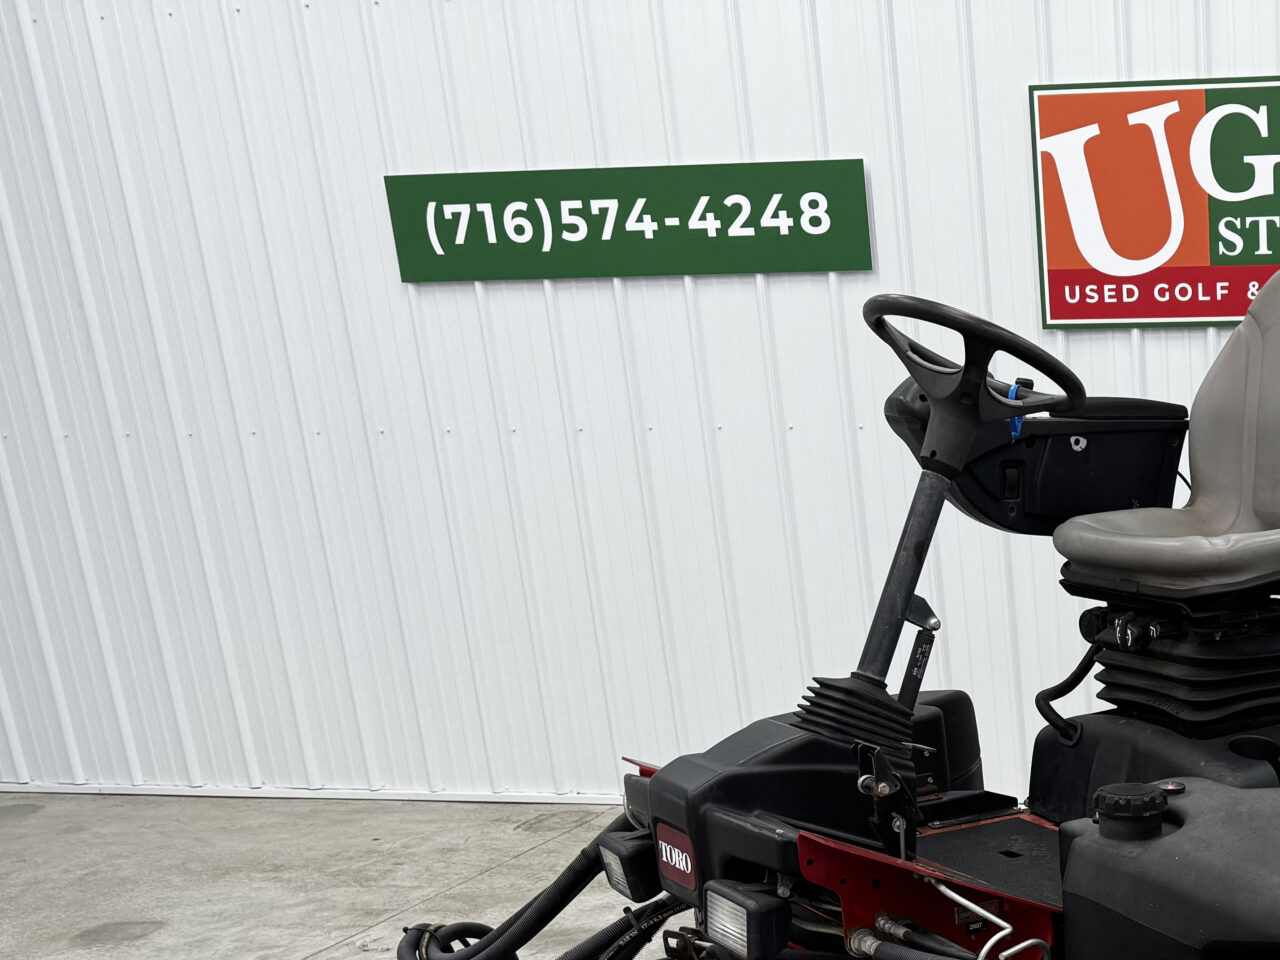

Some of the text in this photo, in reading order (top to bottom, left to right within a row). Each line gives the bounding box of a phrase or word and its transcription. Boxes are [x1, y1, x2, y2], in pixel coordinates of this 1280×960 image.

[425, 191, 832, 256] (716)574-4248
[1064, 284, 1140, 304] USED
[1153, 282, 1230, 302] GOLF
[1246, 281, 1261, 300] &
[658, 840, 692, 874] TORO
